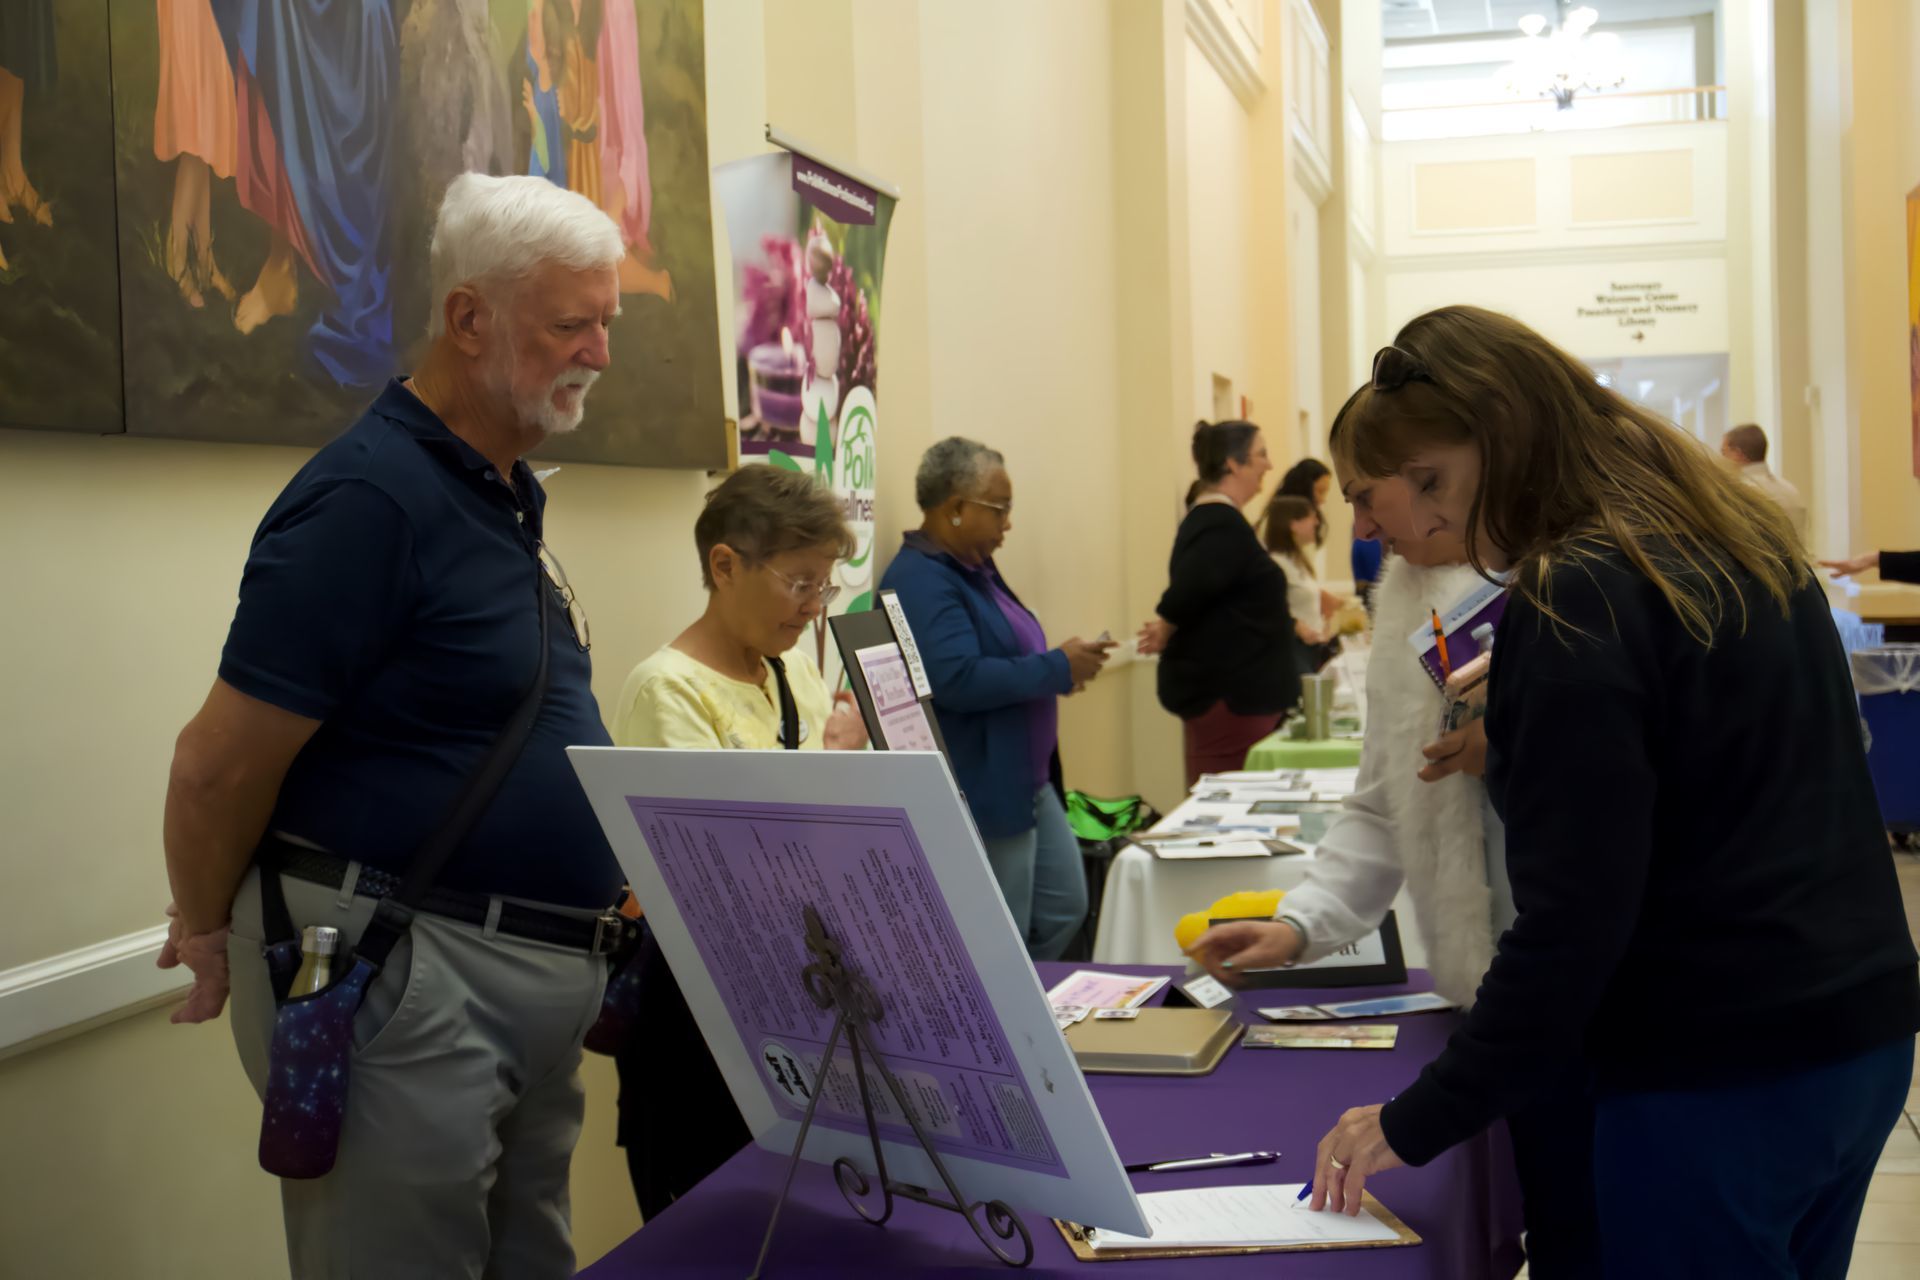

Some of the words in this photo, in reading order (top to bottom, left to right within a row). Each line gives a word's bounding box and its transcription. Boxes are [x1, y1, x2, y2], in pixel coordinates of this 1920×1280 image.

[1596, 295, 1641, 304] Welcome
[1645, 293, 1678, 302] Center
[1577, 307, 1629, 317] Preschool
[1632, 306, 1651, 315] and
[1655, 303, 1699, 313] Nursery
[1618, 317, 1656, 327] Library
